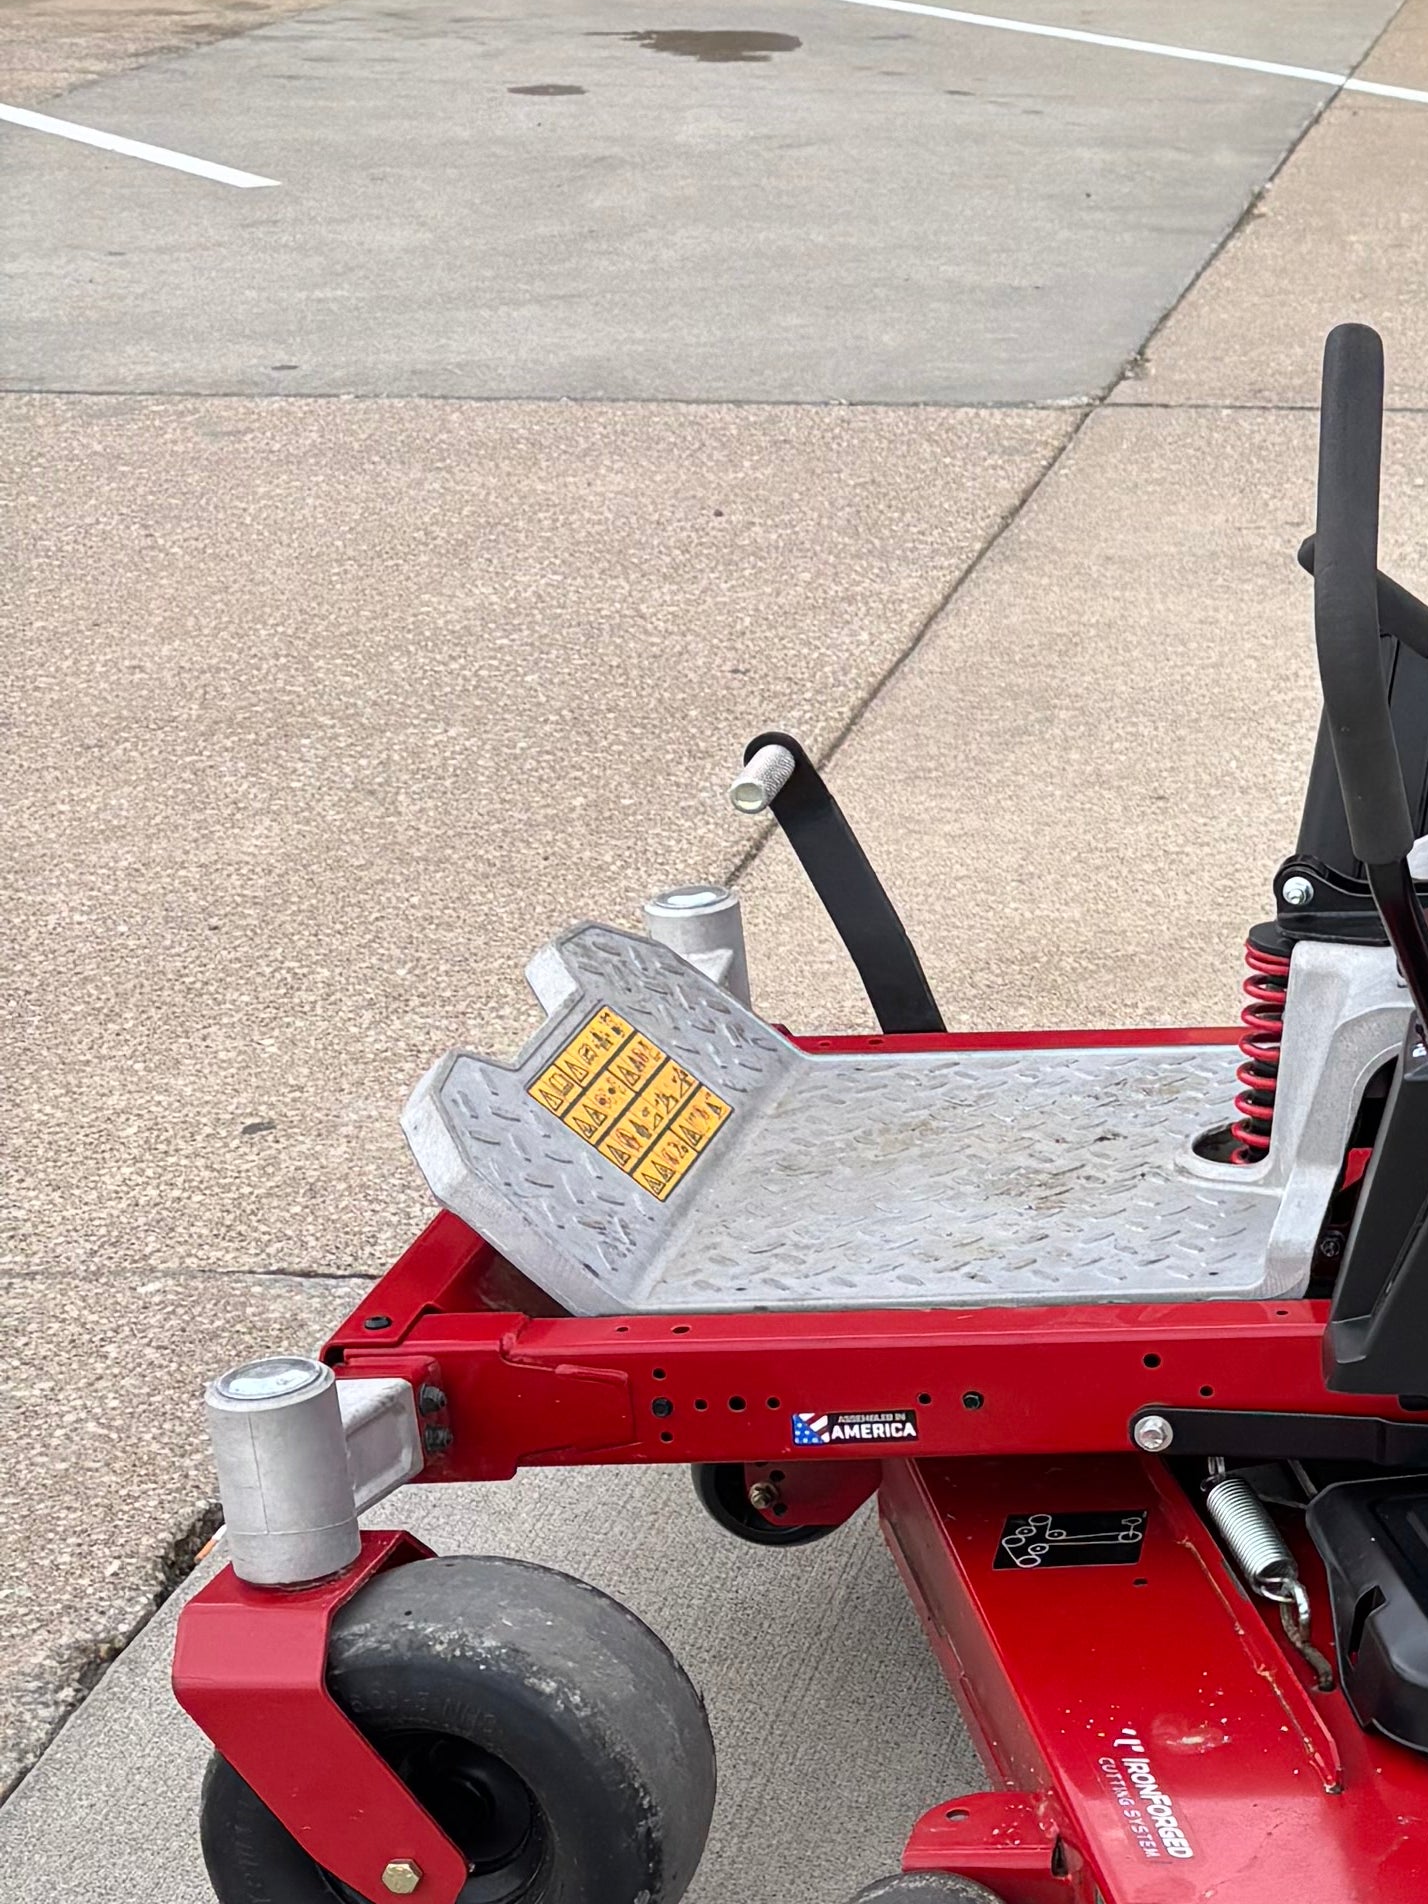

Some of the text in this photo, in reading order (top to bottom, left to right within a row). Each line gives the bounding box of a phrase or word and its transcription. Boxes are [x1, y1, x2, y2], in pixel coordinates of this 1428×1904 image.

[831, 1421, 917, 1440] AMERICA
[837, 1413, 893, 1423] ASSEMBLED
[1098, 1756, 1161, 1858] CUTTING SYSTEM
[1120, 1757, 1194, 1859] IRONFORGED
